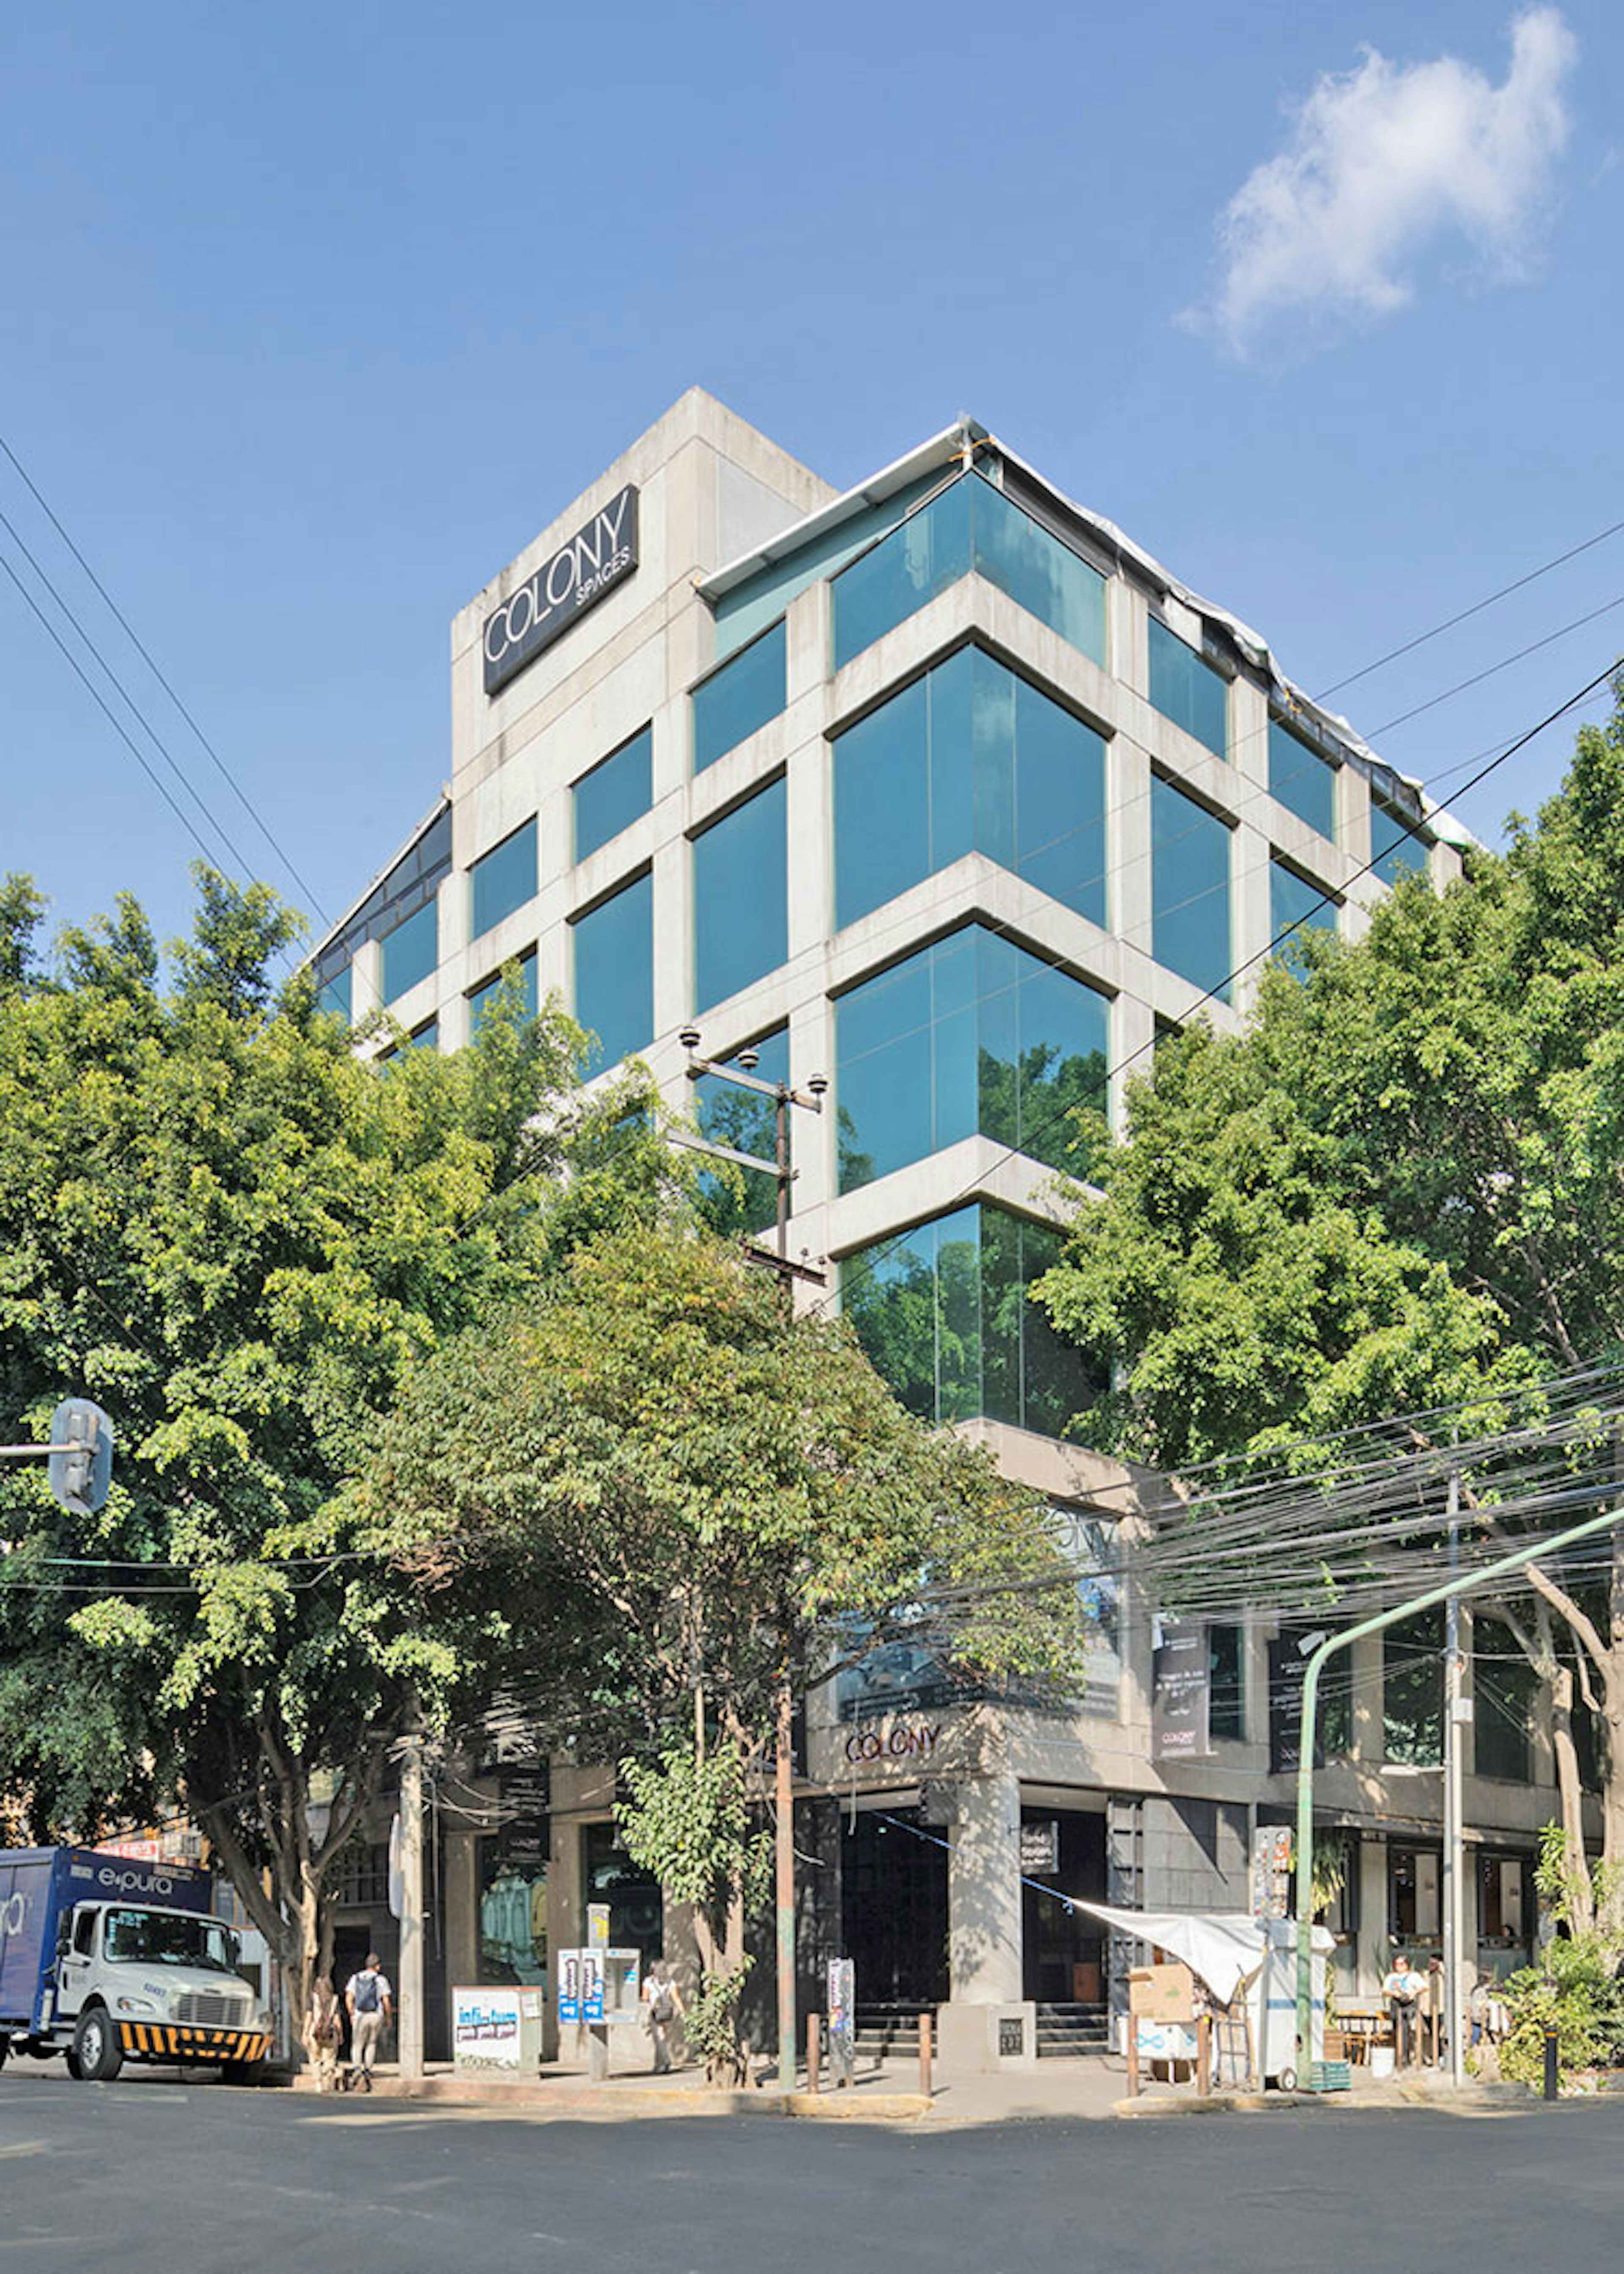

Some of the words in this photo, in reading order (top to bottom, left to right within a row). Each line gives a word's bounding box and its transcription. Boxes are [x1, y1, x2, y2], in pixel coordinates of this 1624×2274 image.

[485, 490, 629, 662] COLONY
[576, 545, 631, 606] SPACES
[846, 1725, 941, 1763] COLONY
